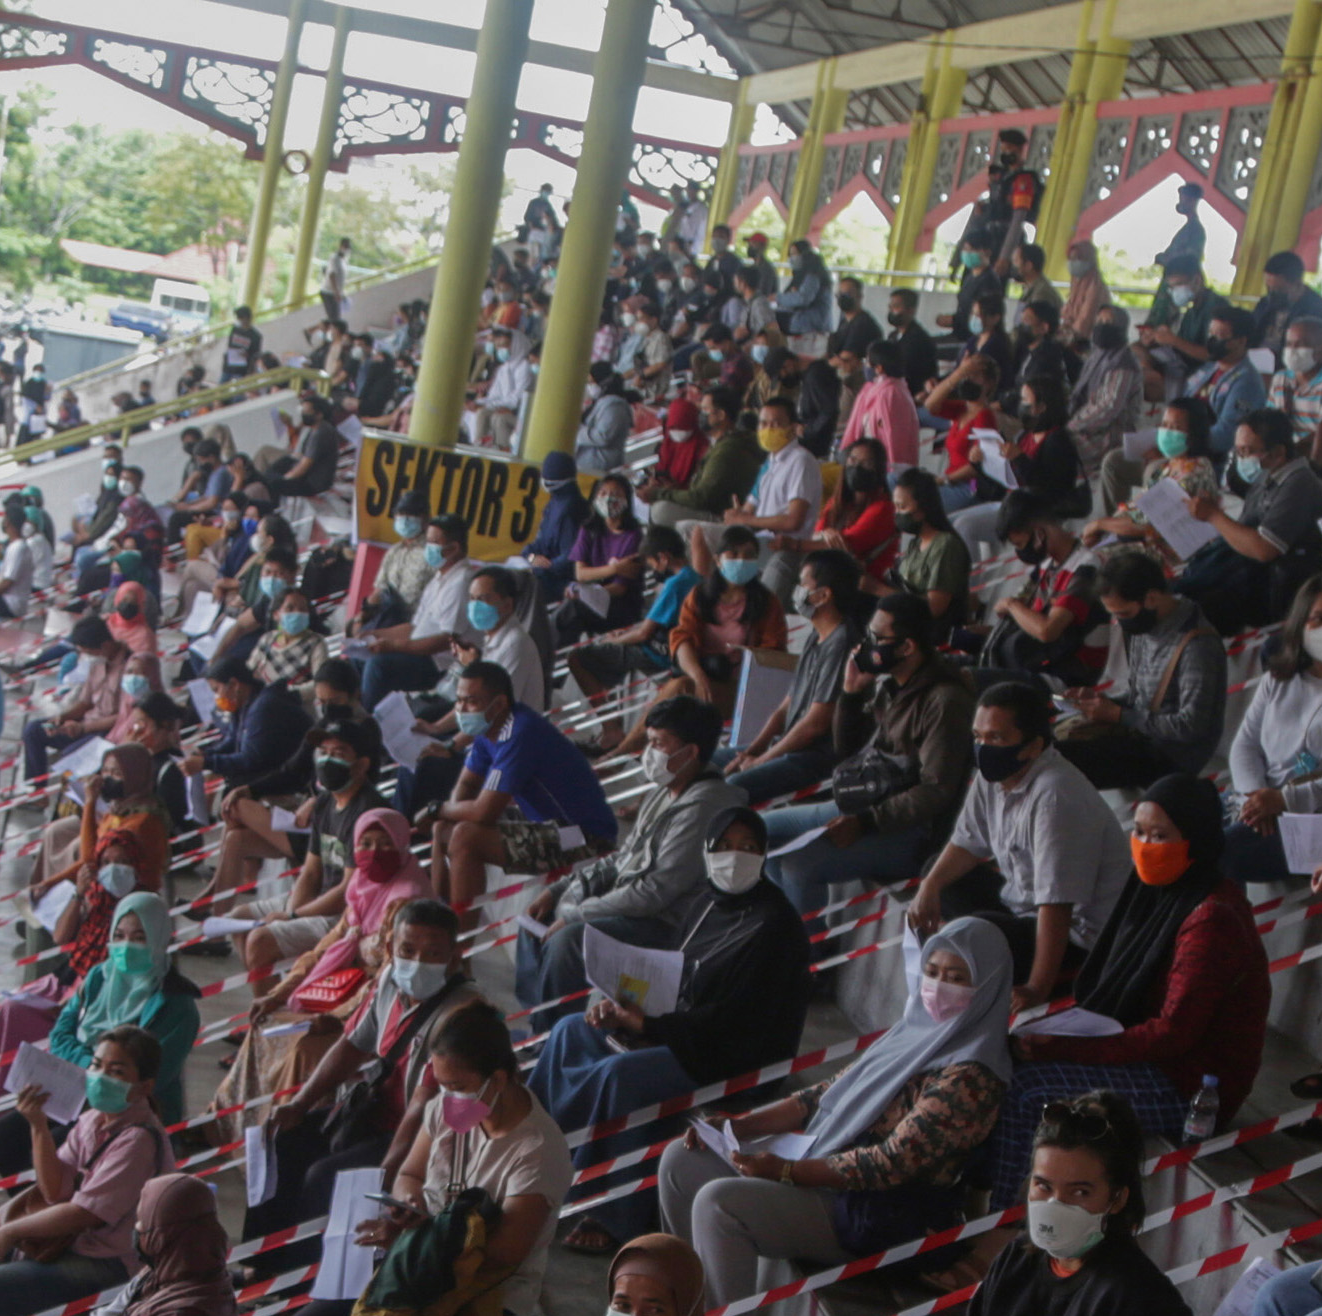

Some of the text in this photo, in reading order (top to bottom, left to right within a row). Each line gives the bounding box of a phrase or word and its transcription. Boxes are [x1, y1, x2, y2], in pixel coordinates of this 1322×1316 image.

[366, 441, 541, 544] SEKTOR 3
[1038, 1223, 1054, 1233] 3M
